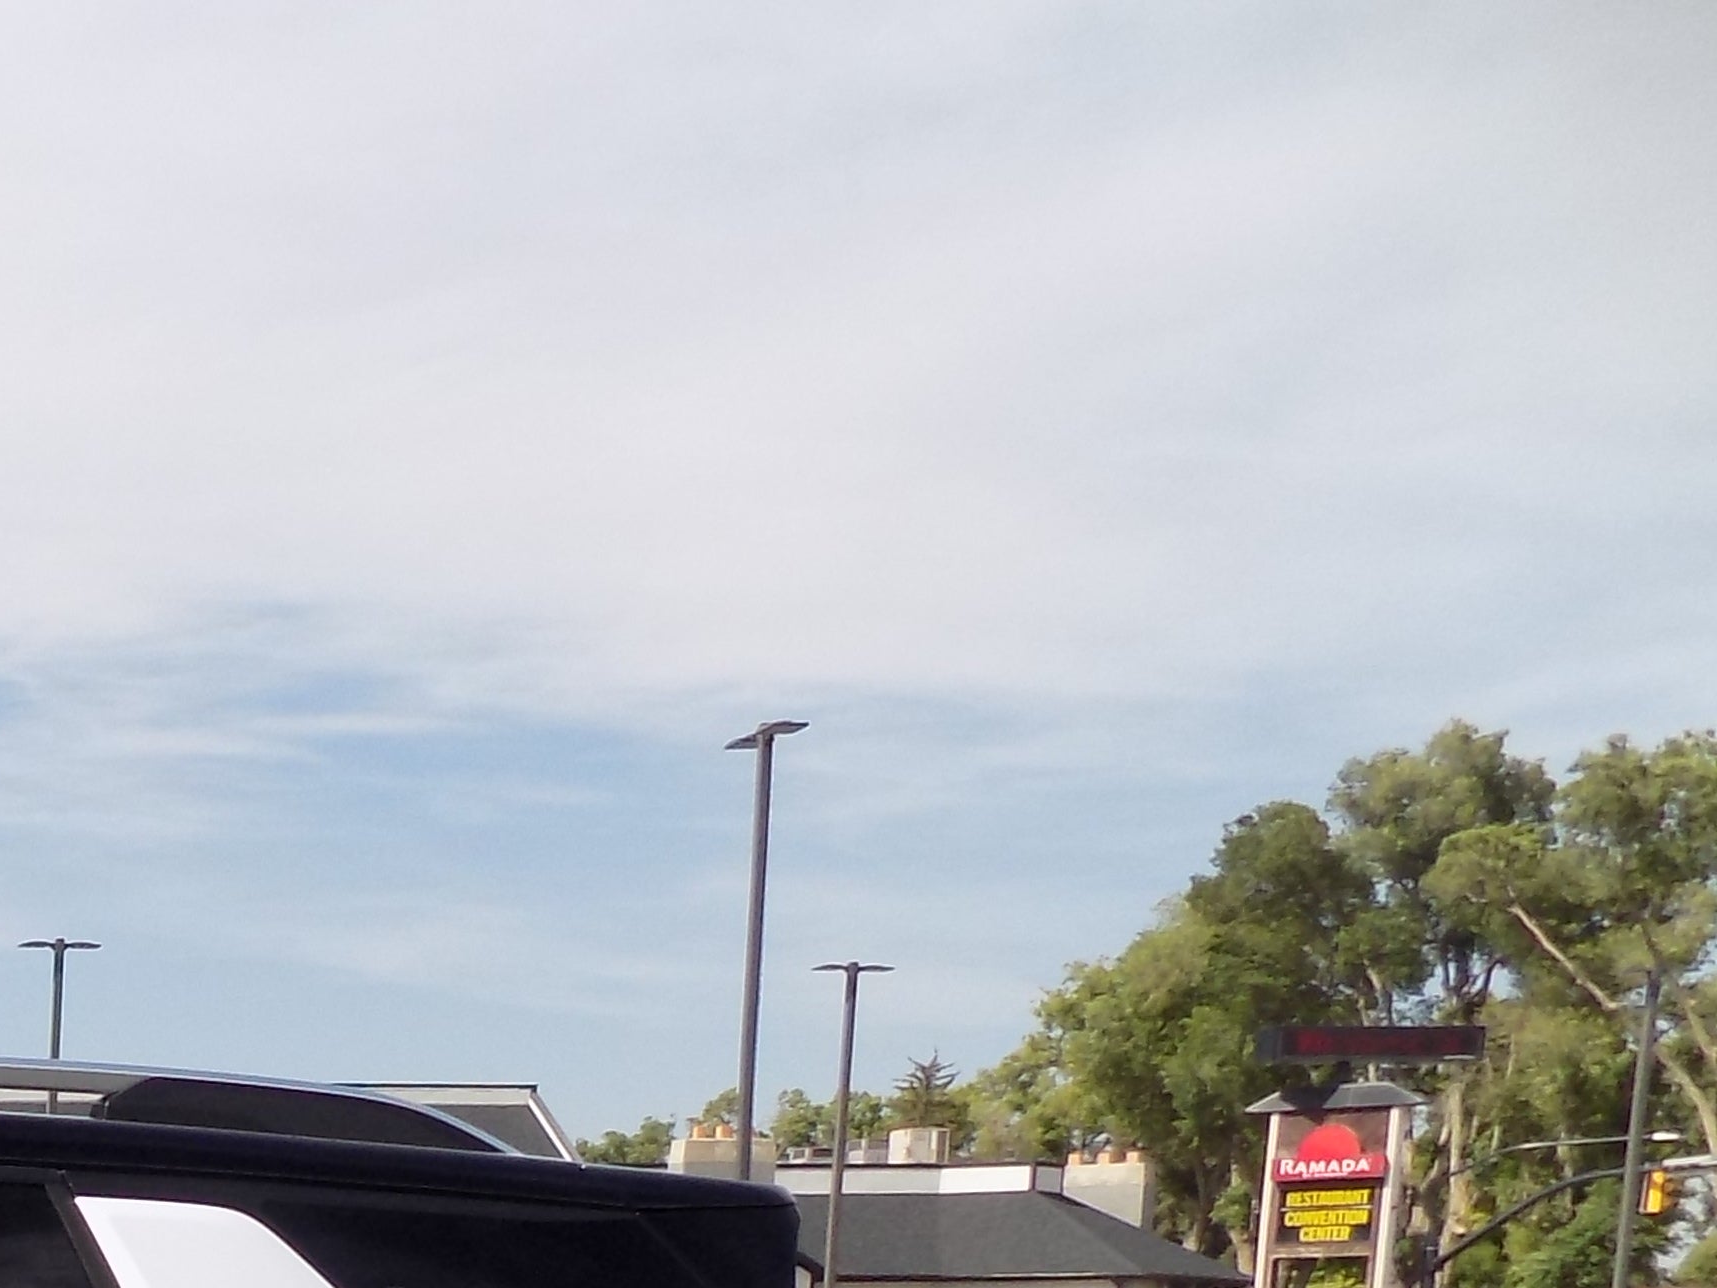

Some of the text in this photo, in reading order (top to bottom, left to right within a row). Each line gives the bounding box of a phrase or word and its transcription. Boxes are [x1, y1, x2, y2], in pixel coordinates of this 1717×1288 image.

[1279, 1158, 1371, 1176] RAMADA
[1285, 1189, 1373, 1207] RESTAURANT
[1284, 1209, 1370, 1228] CONVENTION
[1299, 1226, 1352, 1243] CENTER
